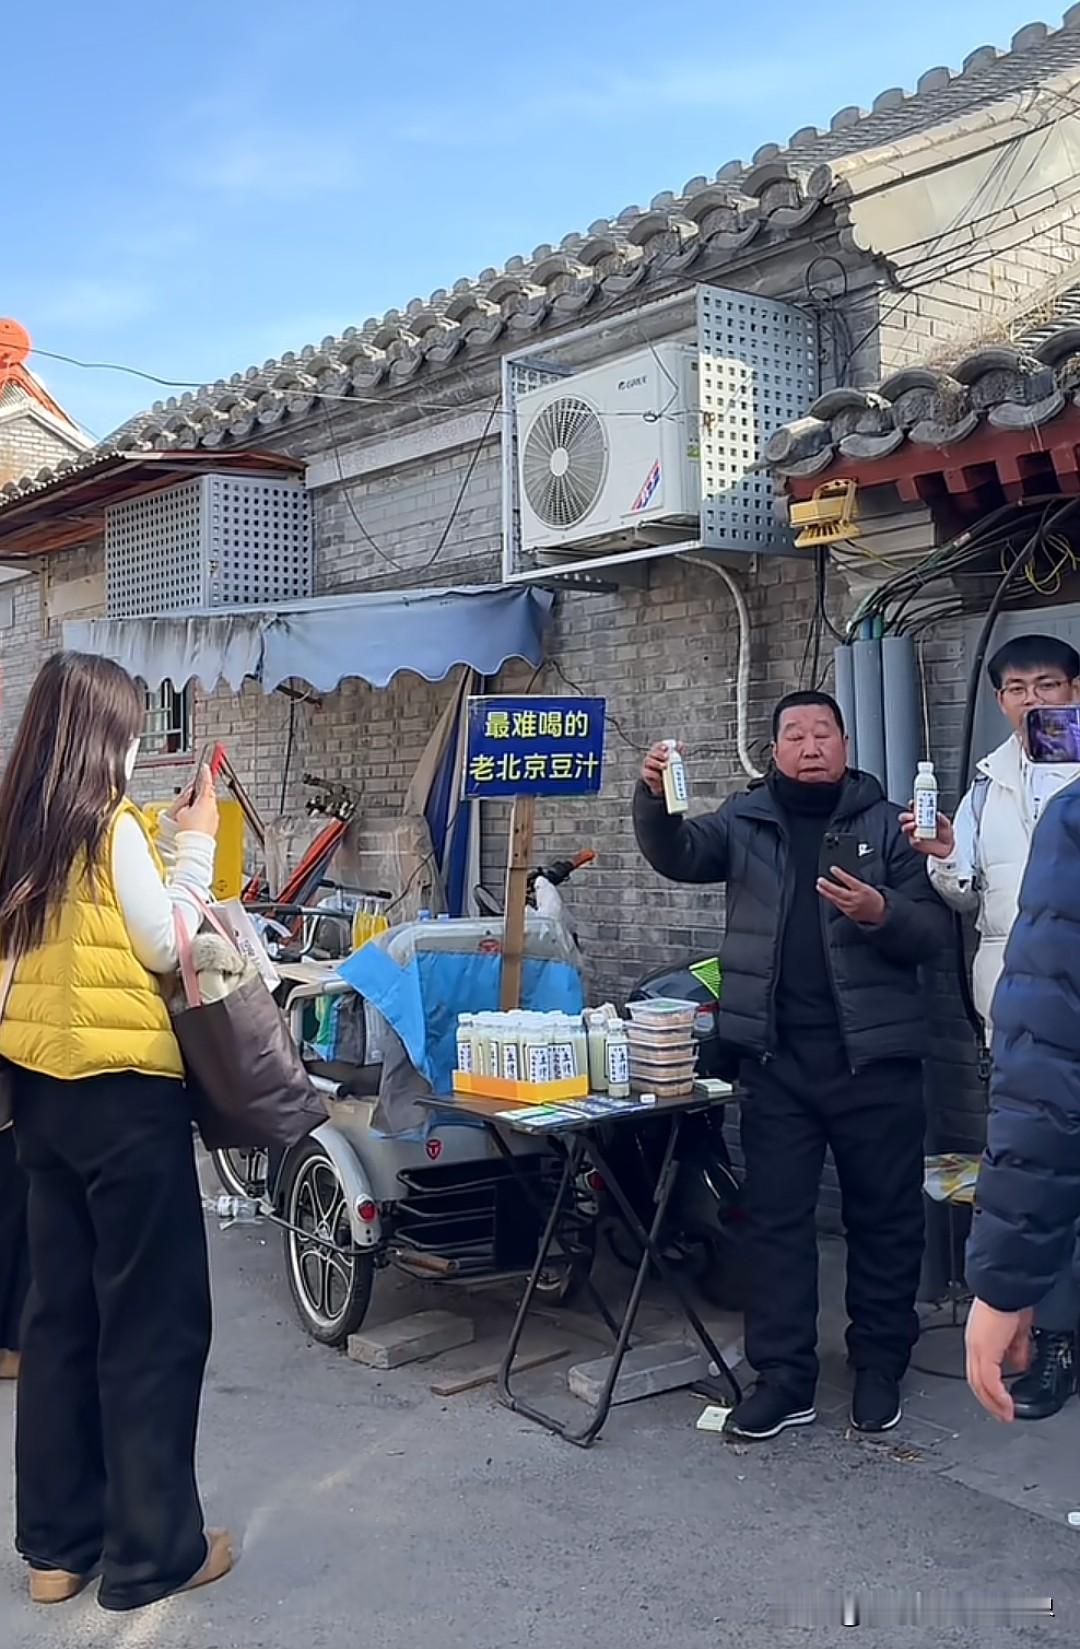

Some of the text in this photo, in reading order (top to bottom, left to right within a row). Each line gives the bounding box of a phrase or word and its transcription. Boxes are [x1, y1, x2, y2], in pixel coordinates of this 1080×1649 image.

[485, 710, 588, 739] 最难喝的
[469, 753, 598, 781] 老北京豆汁
